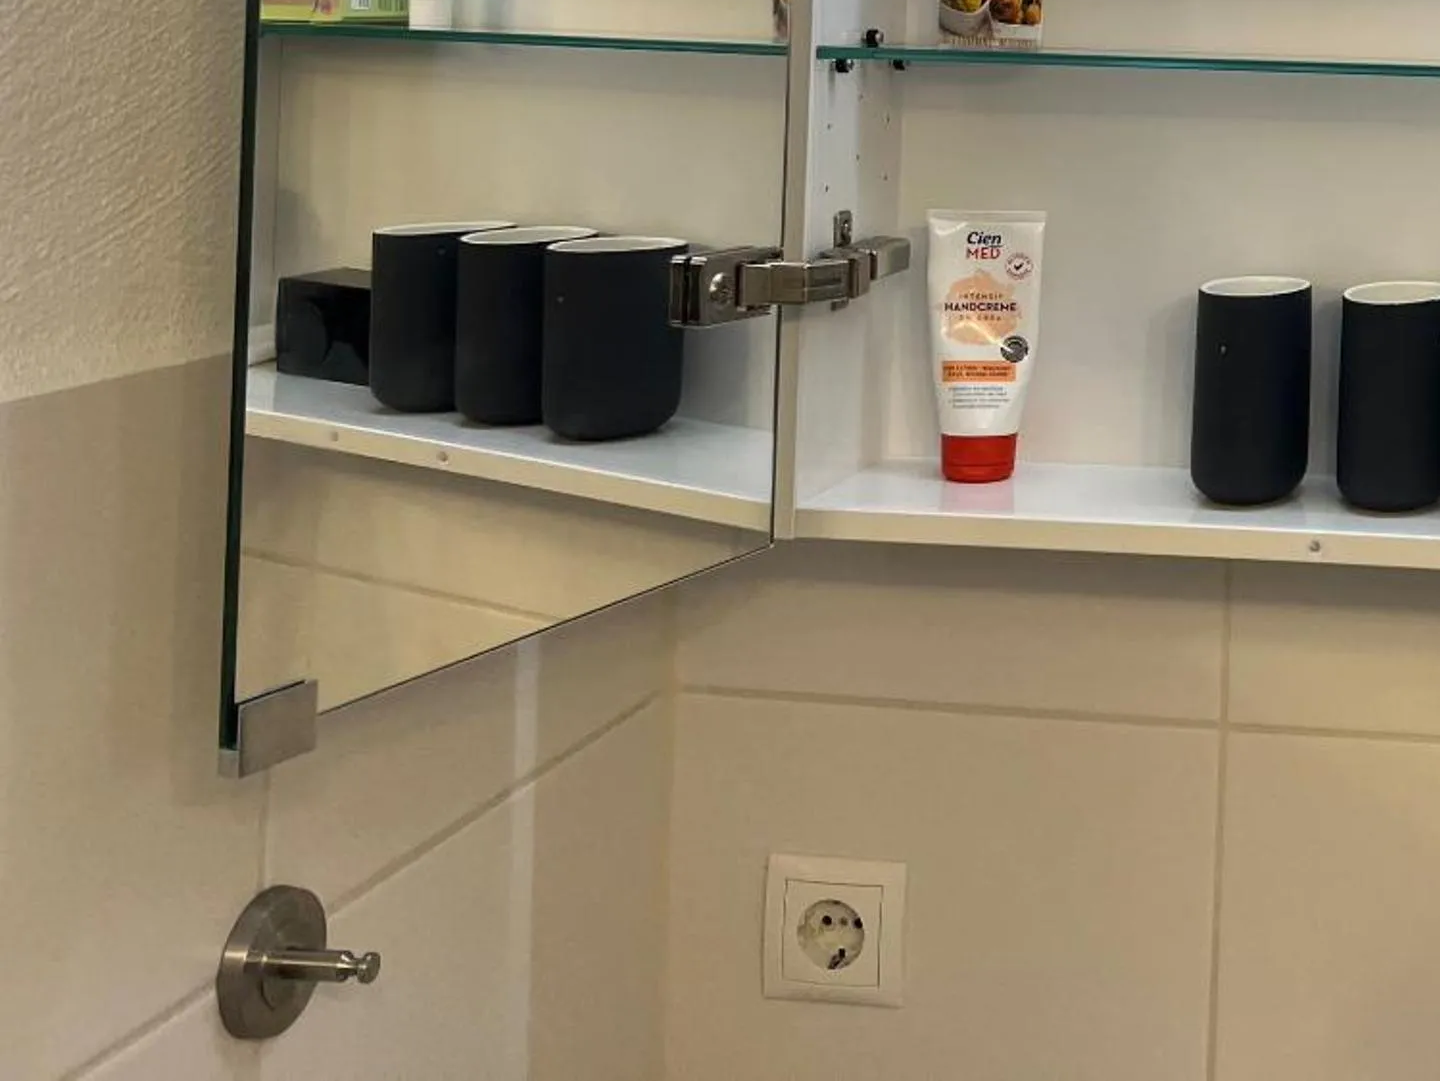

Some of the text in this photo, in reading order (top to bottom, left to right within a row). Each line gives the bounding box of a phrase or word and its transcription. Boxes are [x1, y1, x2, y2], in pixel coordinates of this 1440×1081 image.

[967, 231, 1002, 248] Cien
[967, 247, 1001, 260] MED
[944, 302, 1017, 312] HANDCREME
